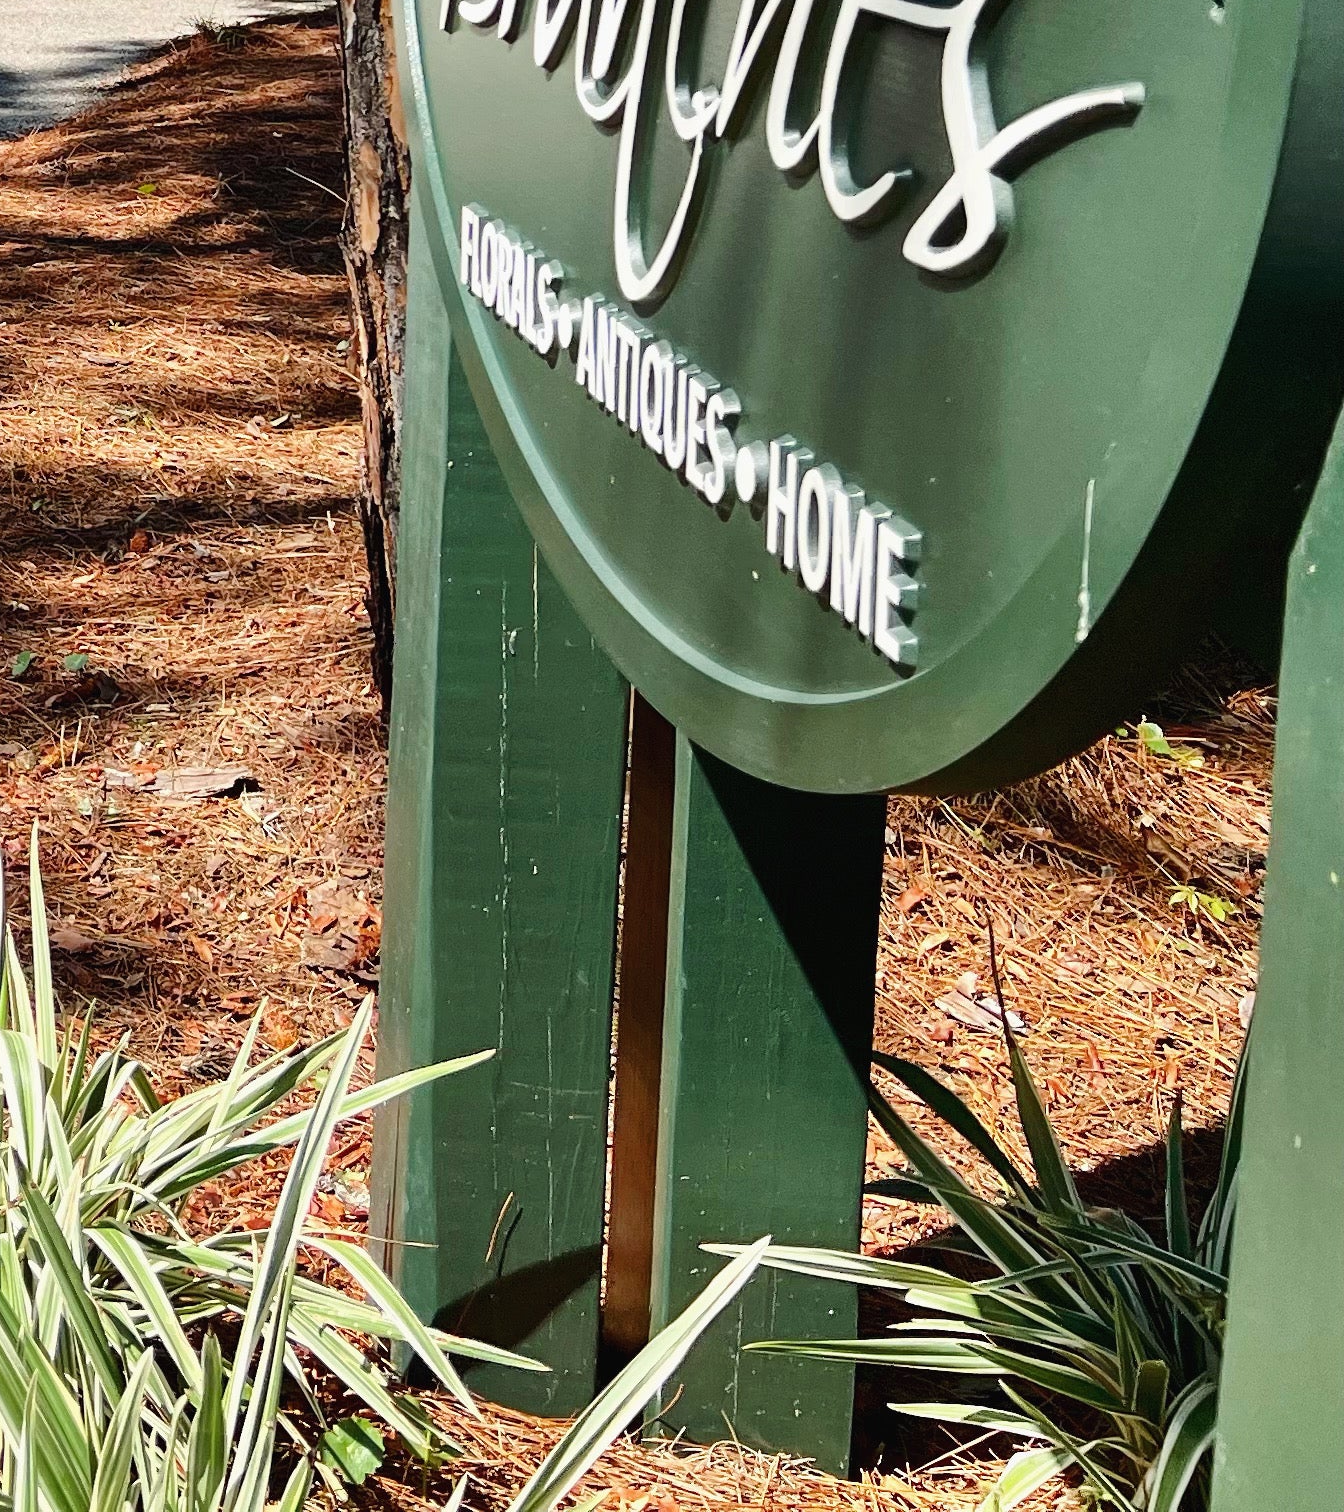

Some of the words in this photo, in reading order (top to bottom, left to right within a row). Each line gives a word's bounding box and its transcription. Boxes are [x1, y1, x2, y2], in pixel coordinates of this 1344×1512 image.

[460, 202, 564, 355] FLORALS
[575, 291, 742, 504] ANTIQUES
[765, 434, 923, 664] HOME
